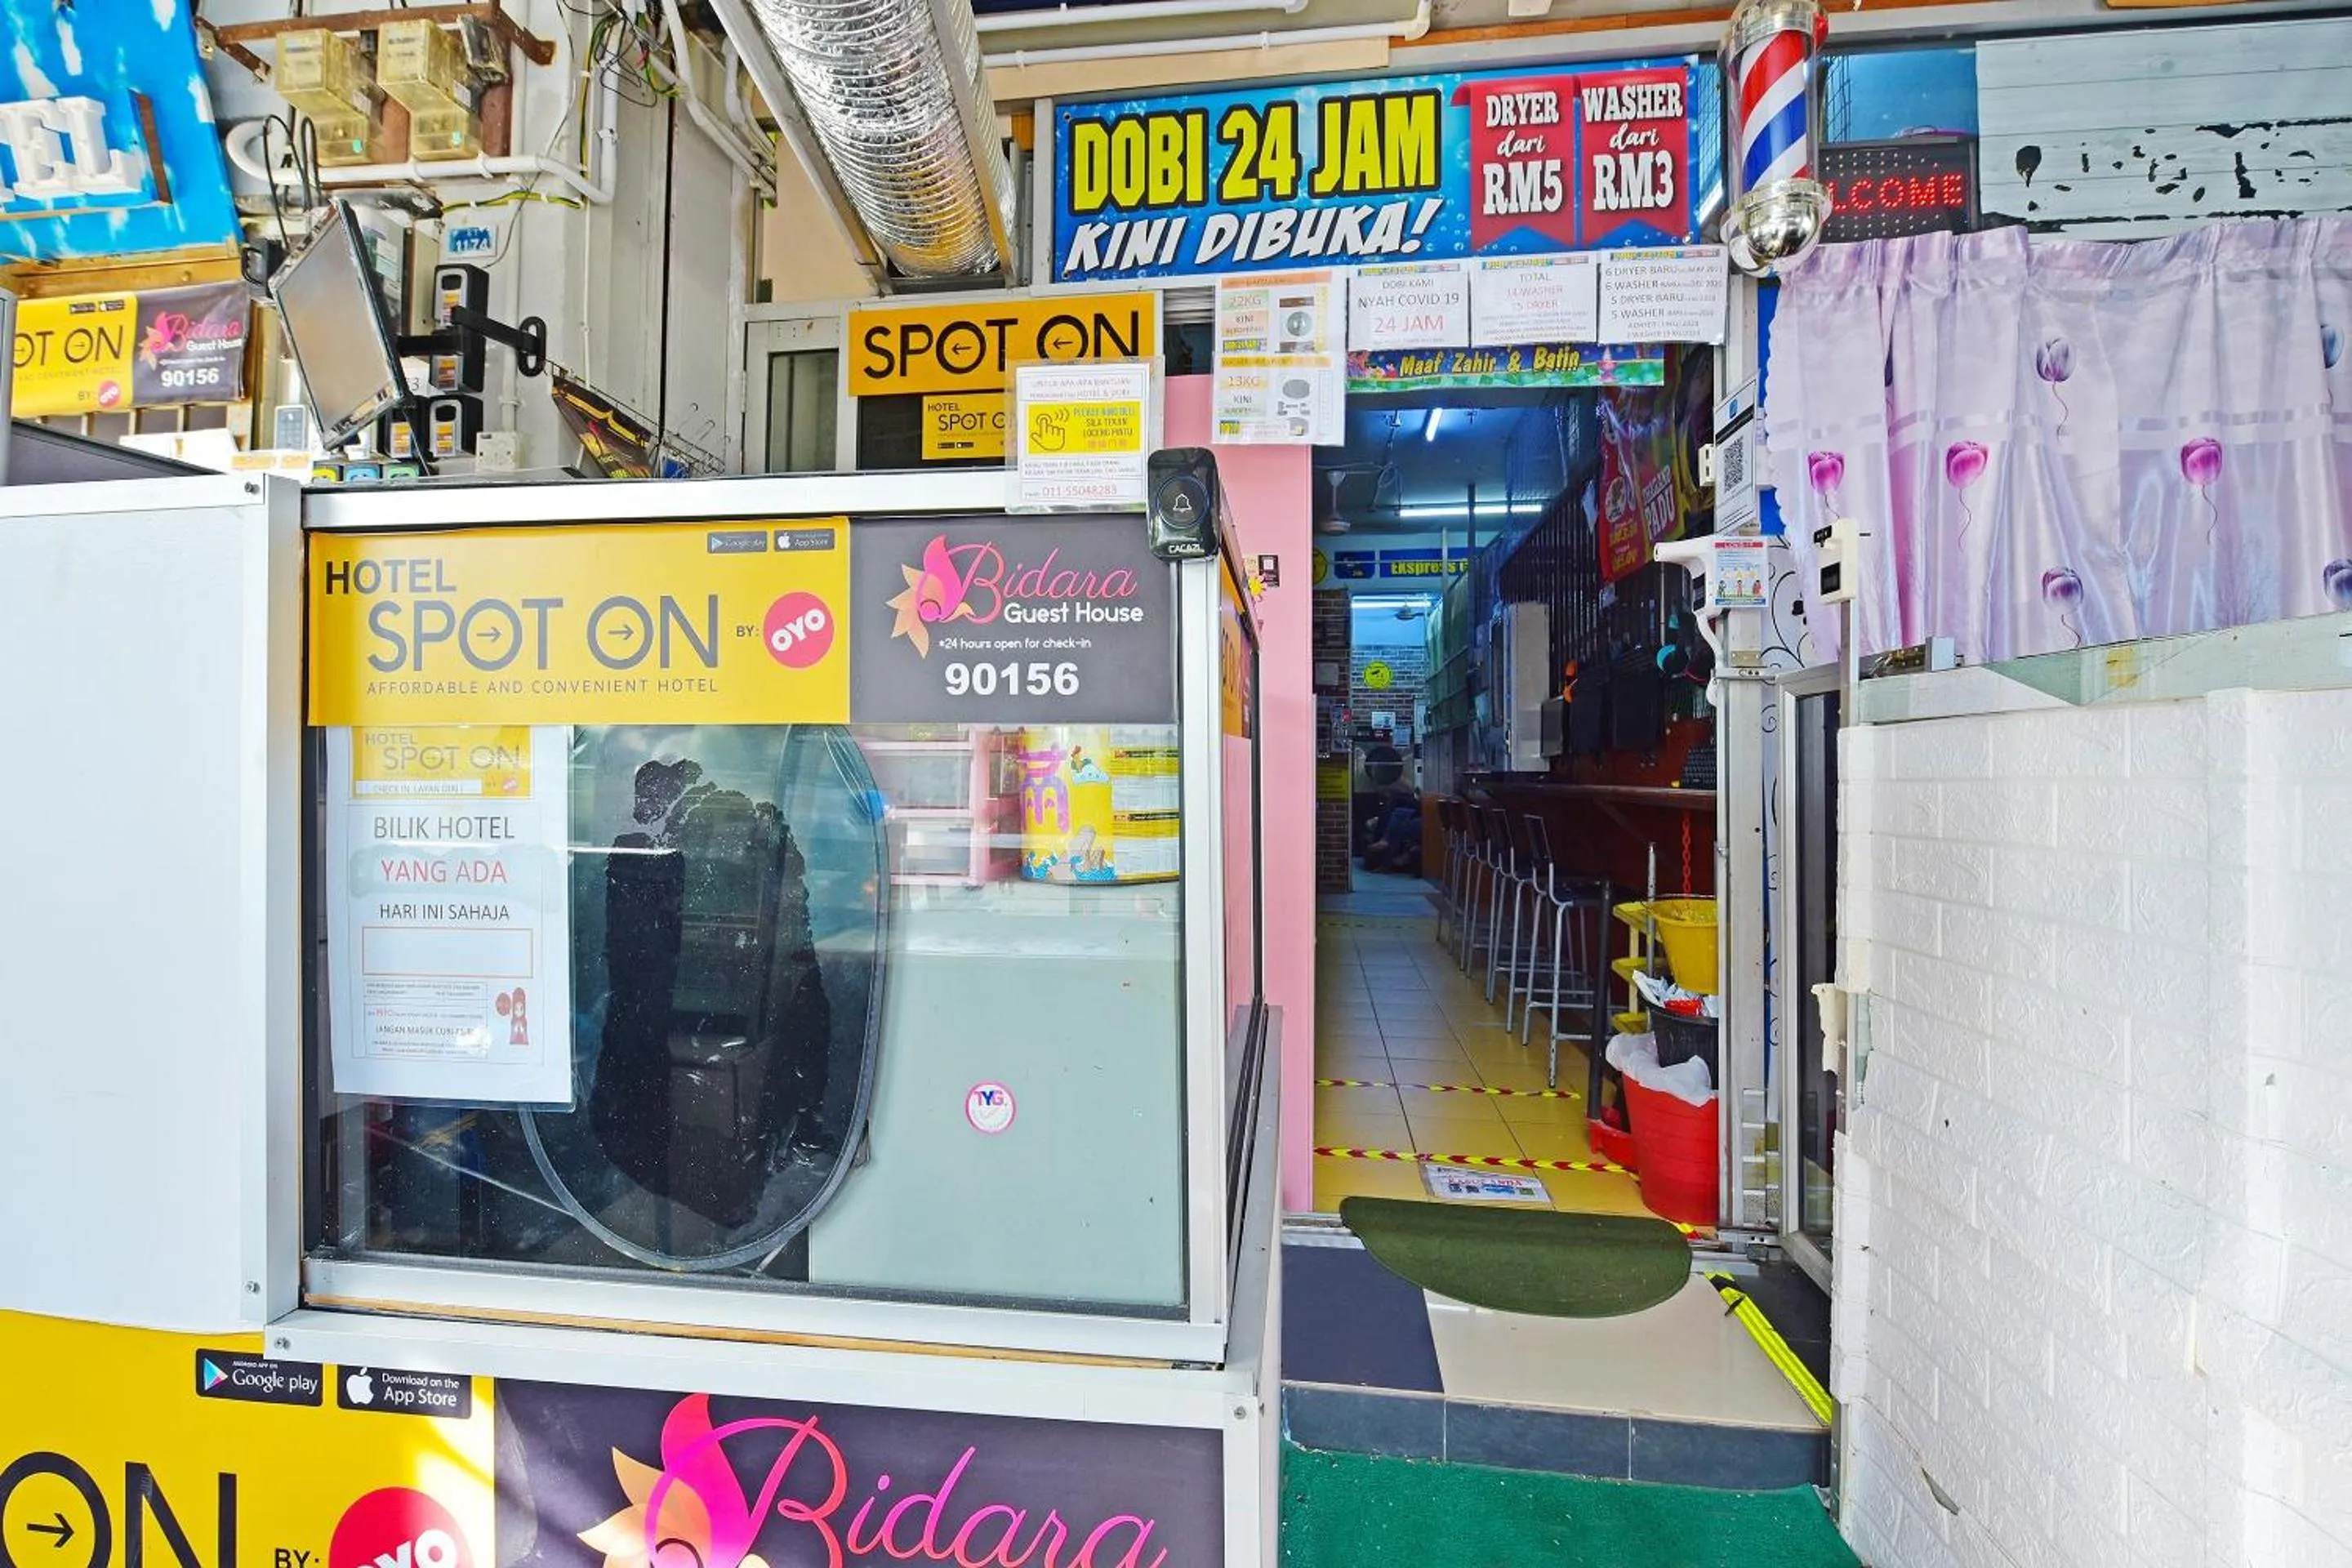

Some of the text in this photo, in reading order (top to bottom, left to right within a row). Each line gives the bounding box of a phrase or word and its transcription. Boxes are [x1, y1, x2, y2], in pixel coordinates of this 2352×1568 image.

[1486, 91, 1559, 127] DRYER
[1582, 82, 1683, 122] WASHER
[1497, 130, 1547, 158] dari
[1610, 122, 1659, 150] dari
[0, 96, 144, 201] EL
[1071, 93, 1437, 213] DOBI 24 JAM
[1483, 159, 1563, 214] RM5
[1593, 150, 1673, 211] RM3
[1064, 198, 1443, 271] KINI DIBUKA!
[1520, 273, 1552, 283] TOTAL
[1615, 267, 1646, 275] DRYER
[1615, 280, 1658, 290] WASHER
[1358, 293, 1459, 308] NYAH COVID 19
[1620, 295, 1652, 305] DRYER
[1374, 315, 1444, 332] 24 JAM
[1620, 310, 1664, 319] WASHER
[65, 325, 123, 363] ON
[864, 310, 1139, 379] SPOT ON
[1400, 346, 1579, 377] Maaf Zahir & Batin
[161, 368, 220, 387] 90156
[928, 403, 960, 412] HOTEL
[938, 412, 987, 431] SPOT
[327, 559, 457, 595] HOTEL
[947, 541, 1139, 624] Bidara
[1004, 602, 1144, 624] Guest House
[368, 595, 718, 671] SPOT ON
[736, 623, 760, 639] BY:
[771, 608, 826, 653] OYO
[960, 638, 991, 650] hours
[994, 639, 1022, 652] open
[1024, 637, 1040, 649] for
[1043, 636, 1092, 649] check-in
[367, 678, 718, 694] AFFORDABLE AND CONVENIENT HOTEL
[945, 662, 1080, 696] 90156
[365, 733, 418, 746] HOTEL
[383, 746, 460, 770] SPOT
[374, 817, 514, 839] BILIK HOTEL
[381, 860, 507, 883] YANG ADA
[380, 904, 510, 920] HARI INI SAHAJA
[232, 1370, 318, 1394] Google play
[382, 1373, 460, 1388] Download on the
[384, 1386, 457, 1407] App Store
[0, 1451, 237, 1568] ON
